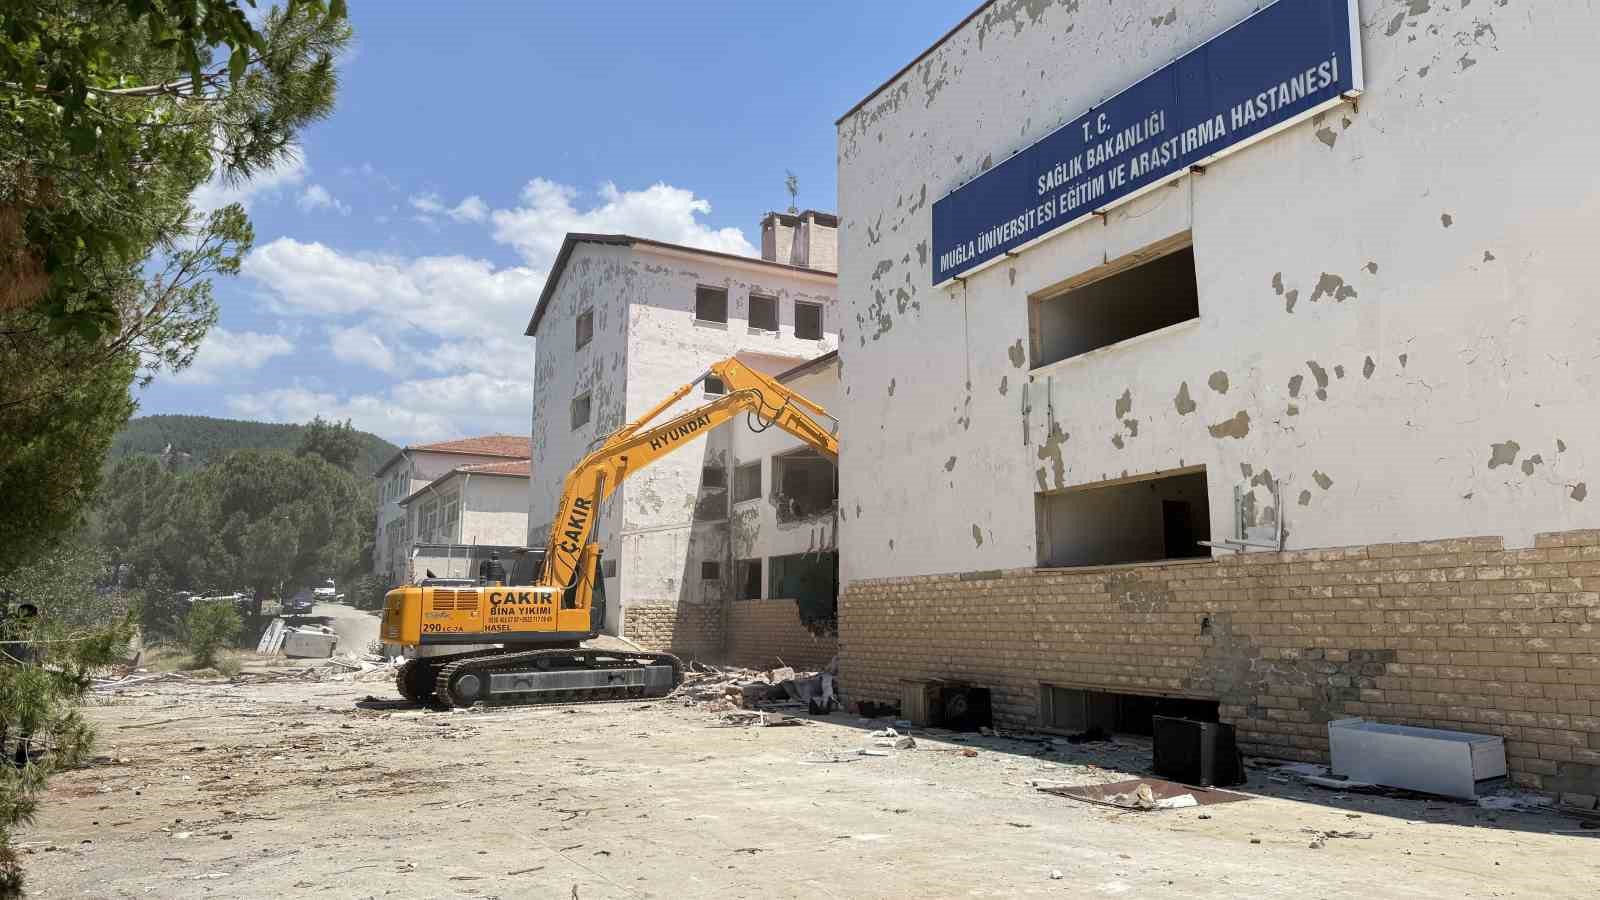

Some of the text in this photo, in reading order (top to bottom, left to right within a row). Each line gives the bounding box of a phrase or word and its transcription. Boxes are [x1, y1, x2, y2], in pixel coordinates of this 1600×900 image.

[1082, 112, 1111, 142] T. C.
[940, 52, 1339, 273] MUĞLA ÜNİVERSİTESİ EĞİTİM VE ARAŞTIRMA HASTANESİ
[1038, 109, 1165, 195] SAĞLIK BAKANLIĞI
[650, 414, 712, 451] HYUNDAI
[560, 497, 592, 555] ÇAKIR
[489, 592, 553, 608] ÇAKIR
[518, 607, 551, 615] YIKIMI
[423, 624, 441, 632] 290
[484, 624, 512, 632] HASEL
